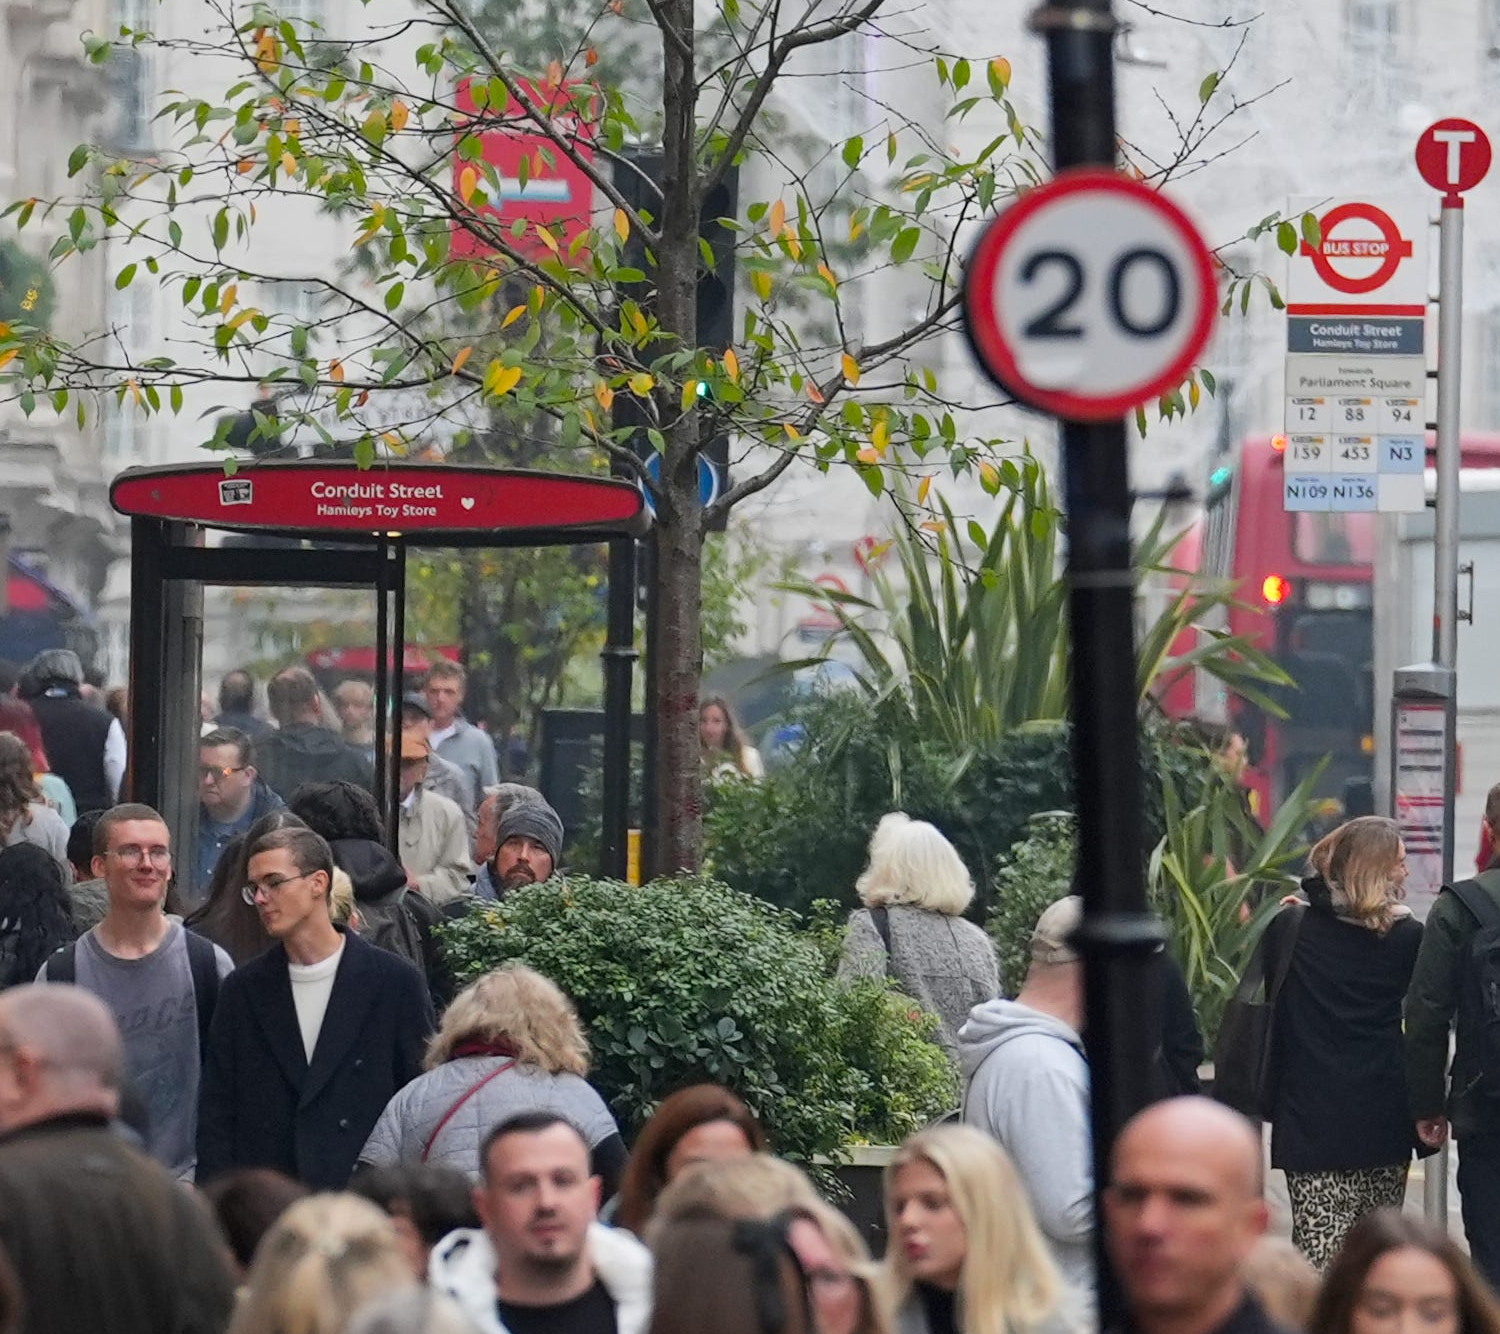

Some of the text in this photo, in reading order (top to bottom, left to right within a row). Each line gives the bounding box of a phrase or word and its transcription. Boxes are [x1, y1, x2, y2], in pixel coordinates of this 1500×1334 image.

[1432, 130, 1475, 185] T
[1323, 241, 1390, 255] BUS STOP
[1019, 248, 1182, 340] 20
[1309, 324, 1403, 337] Conduit Street
[1300, 377, 1411, 390] Parliament Square
[1299, 407, 1316, 421] 12
[1345, 407, 1365, 421] 88
[1392, 408, 1412, 422] 94
[1293, 447, 1321, 460] 159
[1341, 447, 1370, 460] 453
[1390, 447, 1412, 460] N3
[311, 481, 444, 499] Conduit Street
[1287, 486, 1328, 499] N109
[1333, 486, 1374, 499] N136
[317, 504, 437, 517] Hamleys Toy Store
